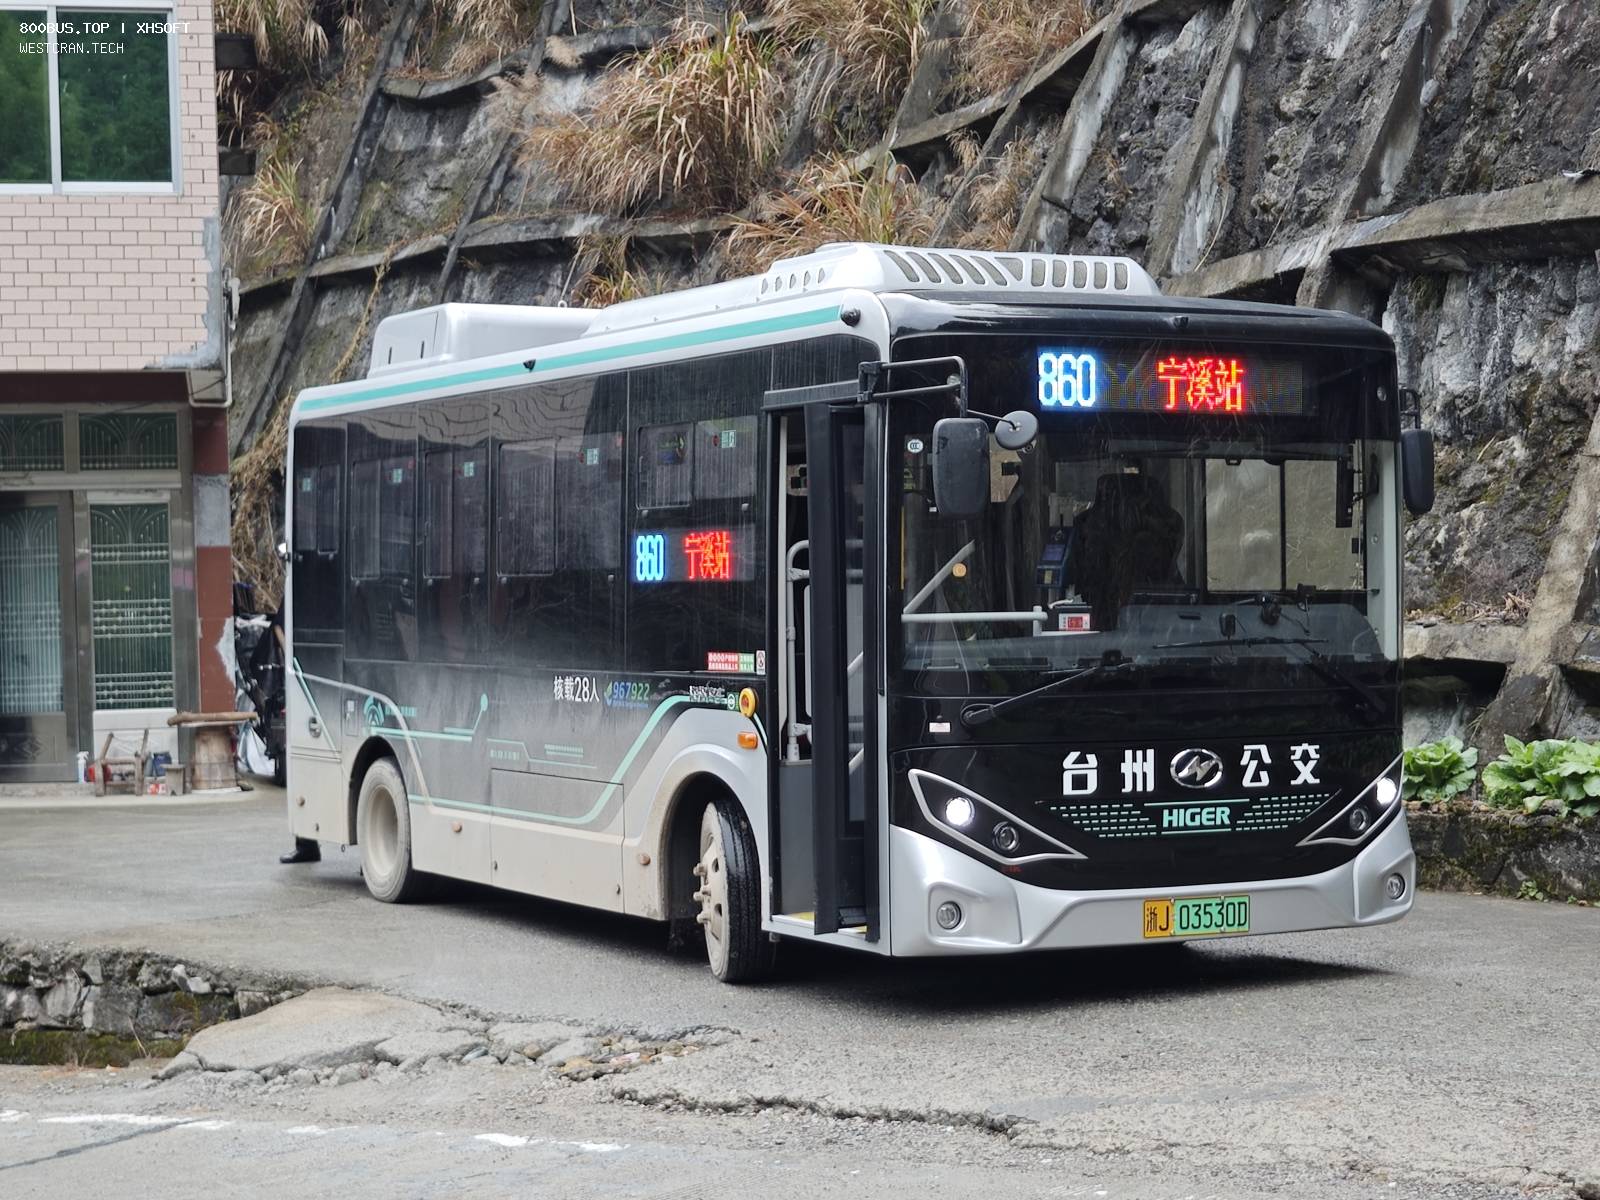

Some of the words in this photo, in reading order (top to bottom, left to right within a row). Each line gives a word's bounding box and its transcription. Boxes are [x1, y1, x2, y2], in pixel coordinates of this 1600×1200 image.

[1038, 352, 1096, 407] 860
[1158, 356, 1244, 411] 宁溪站
[635, 534, 665, 581] 860
[684, 530, 732, 580] 宁溪站
[553, 675, 600, 702] 核载28人
[612, 681, 650, 701] 967922
[1162, 806, 1231, 828] HIGER
